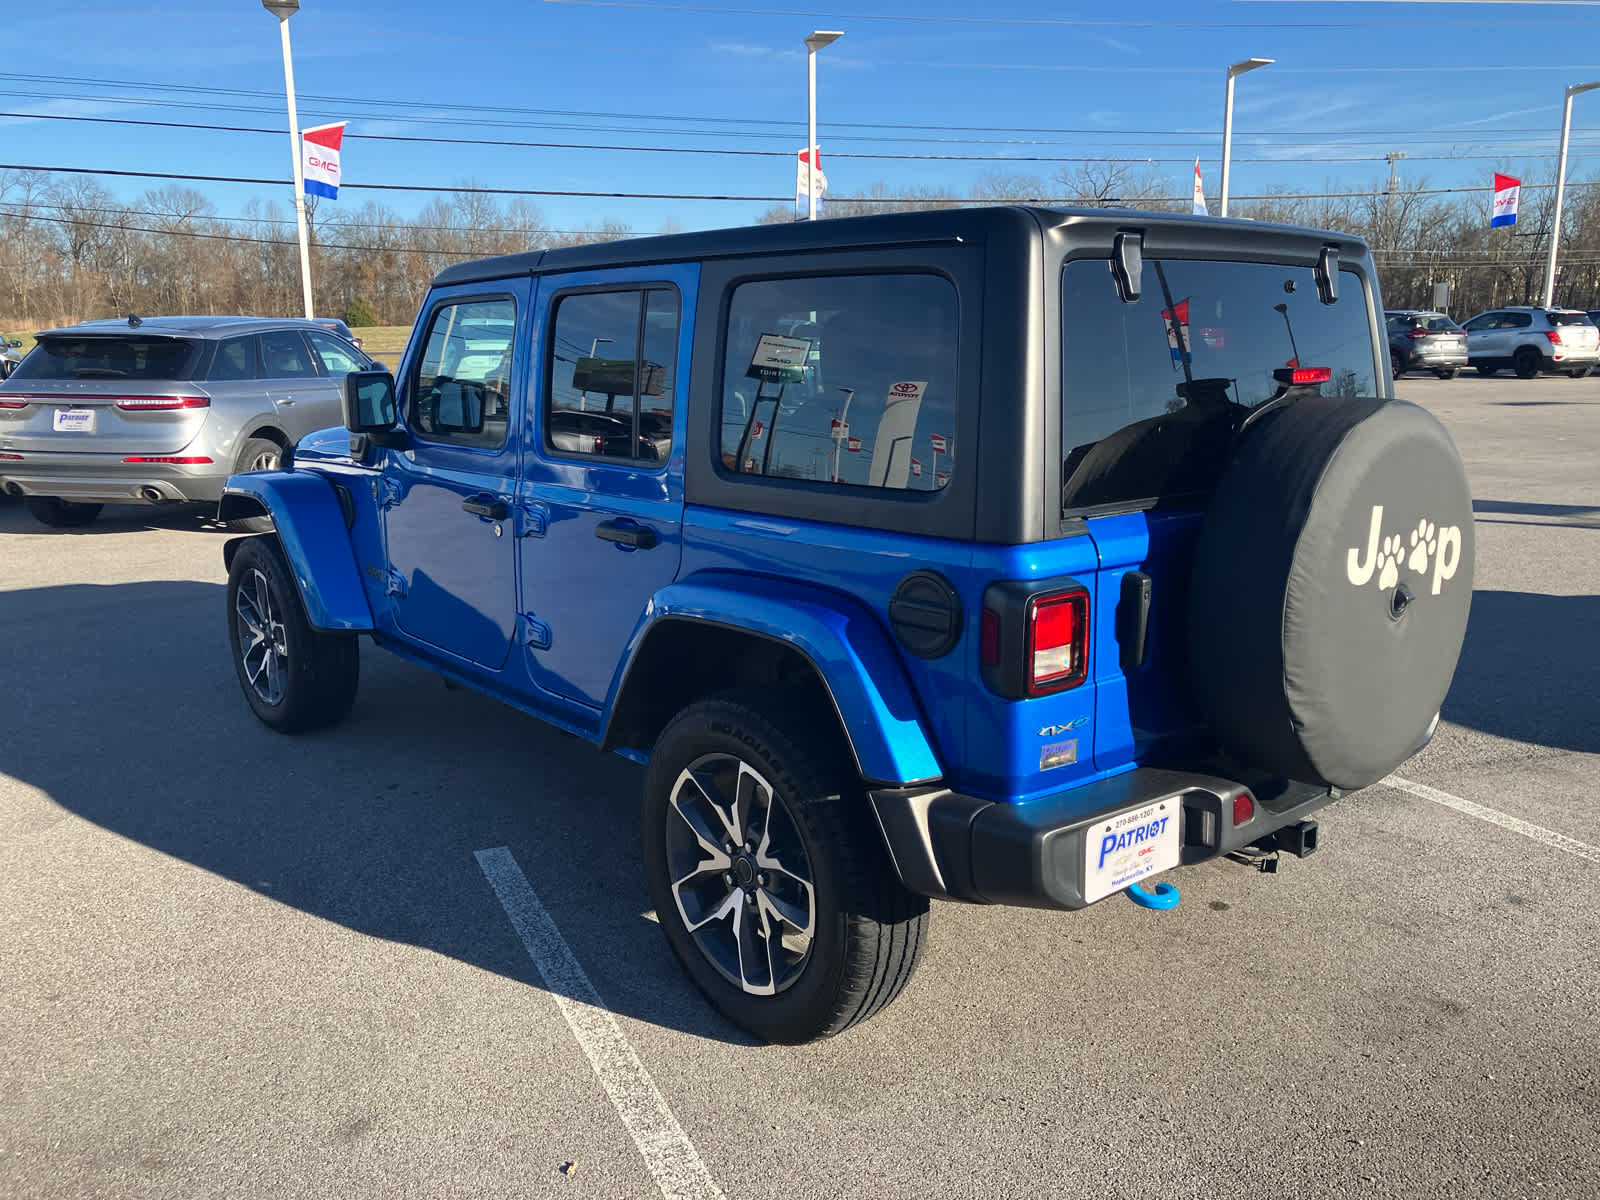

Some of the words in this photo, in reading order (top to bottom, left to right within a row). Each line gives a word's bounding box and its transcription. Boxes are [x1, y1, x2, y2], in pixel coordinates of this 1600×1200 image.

[308, 156, 338, 173] GMC
[1098, 816, 1169, 869] PATRIOT
[1138, 846, 1155, 857] GMC
